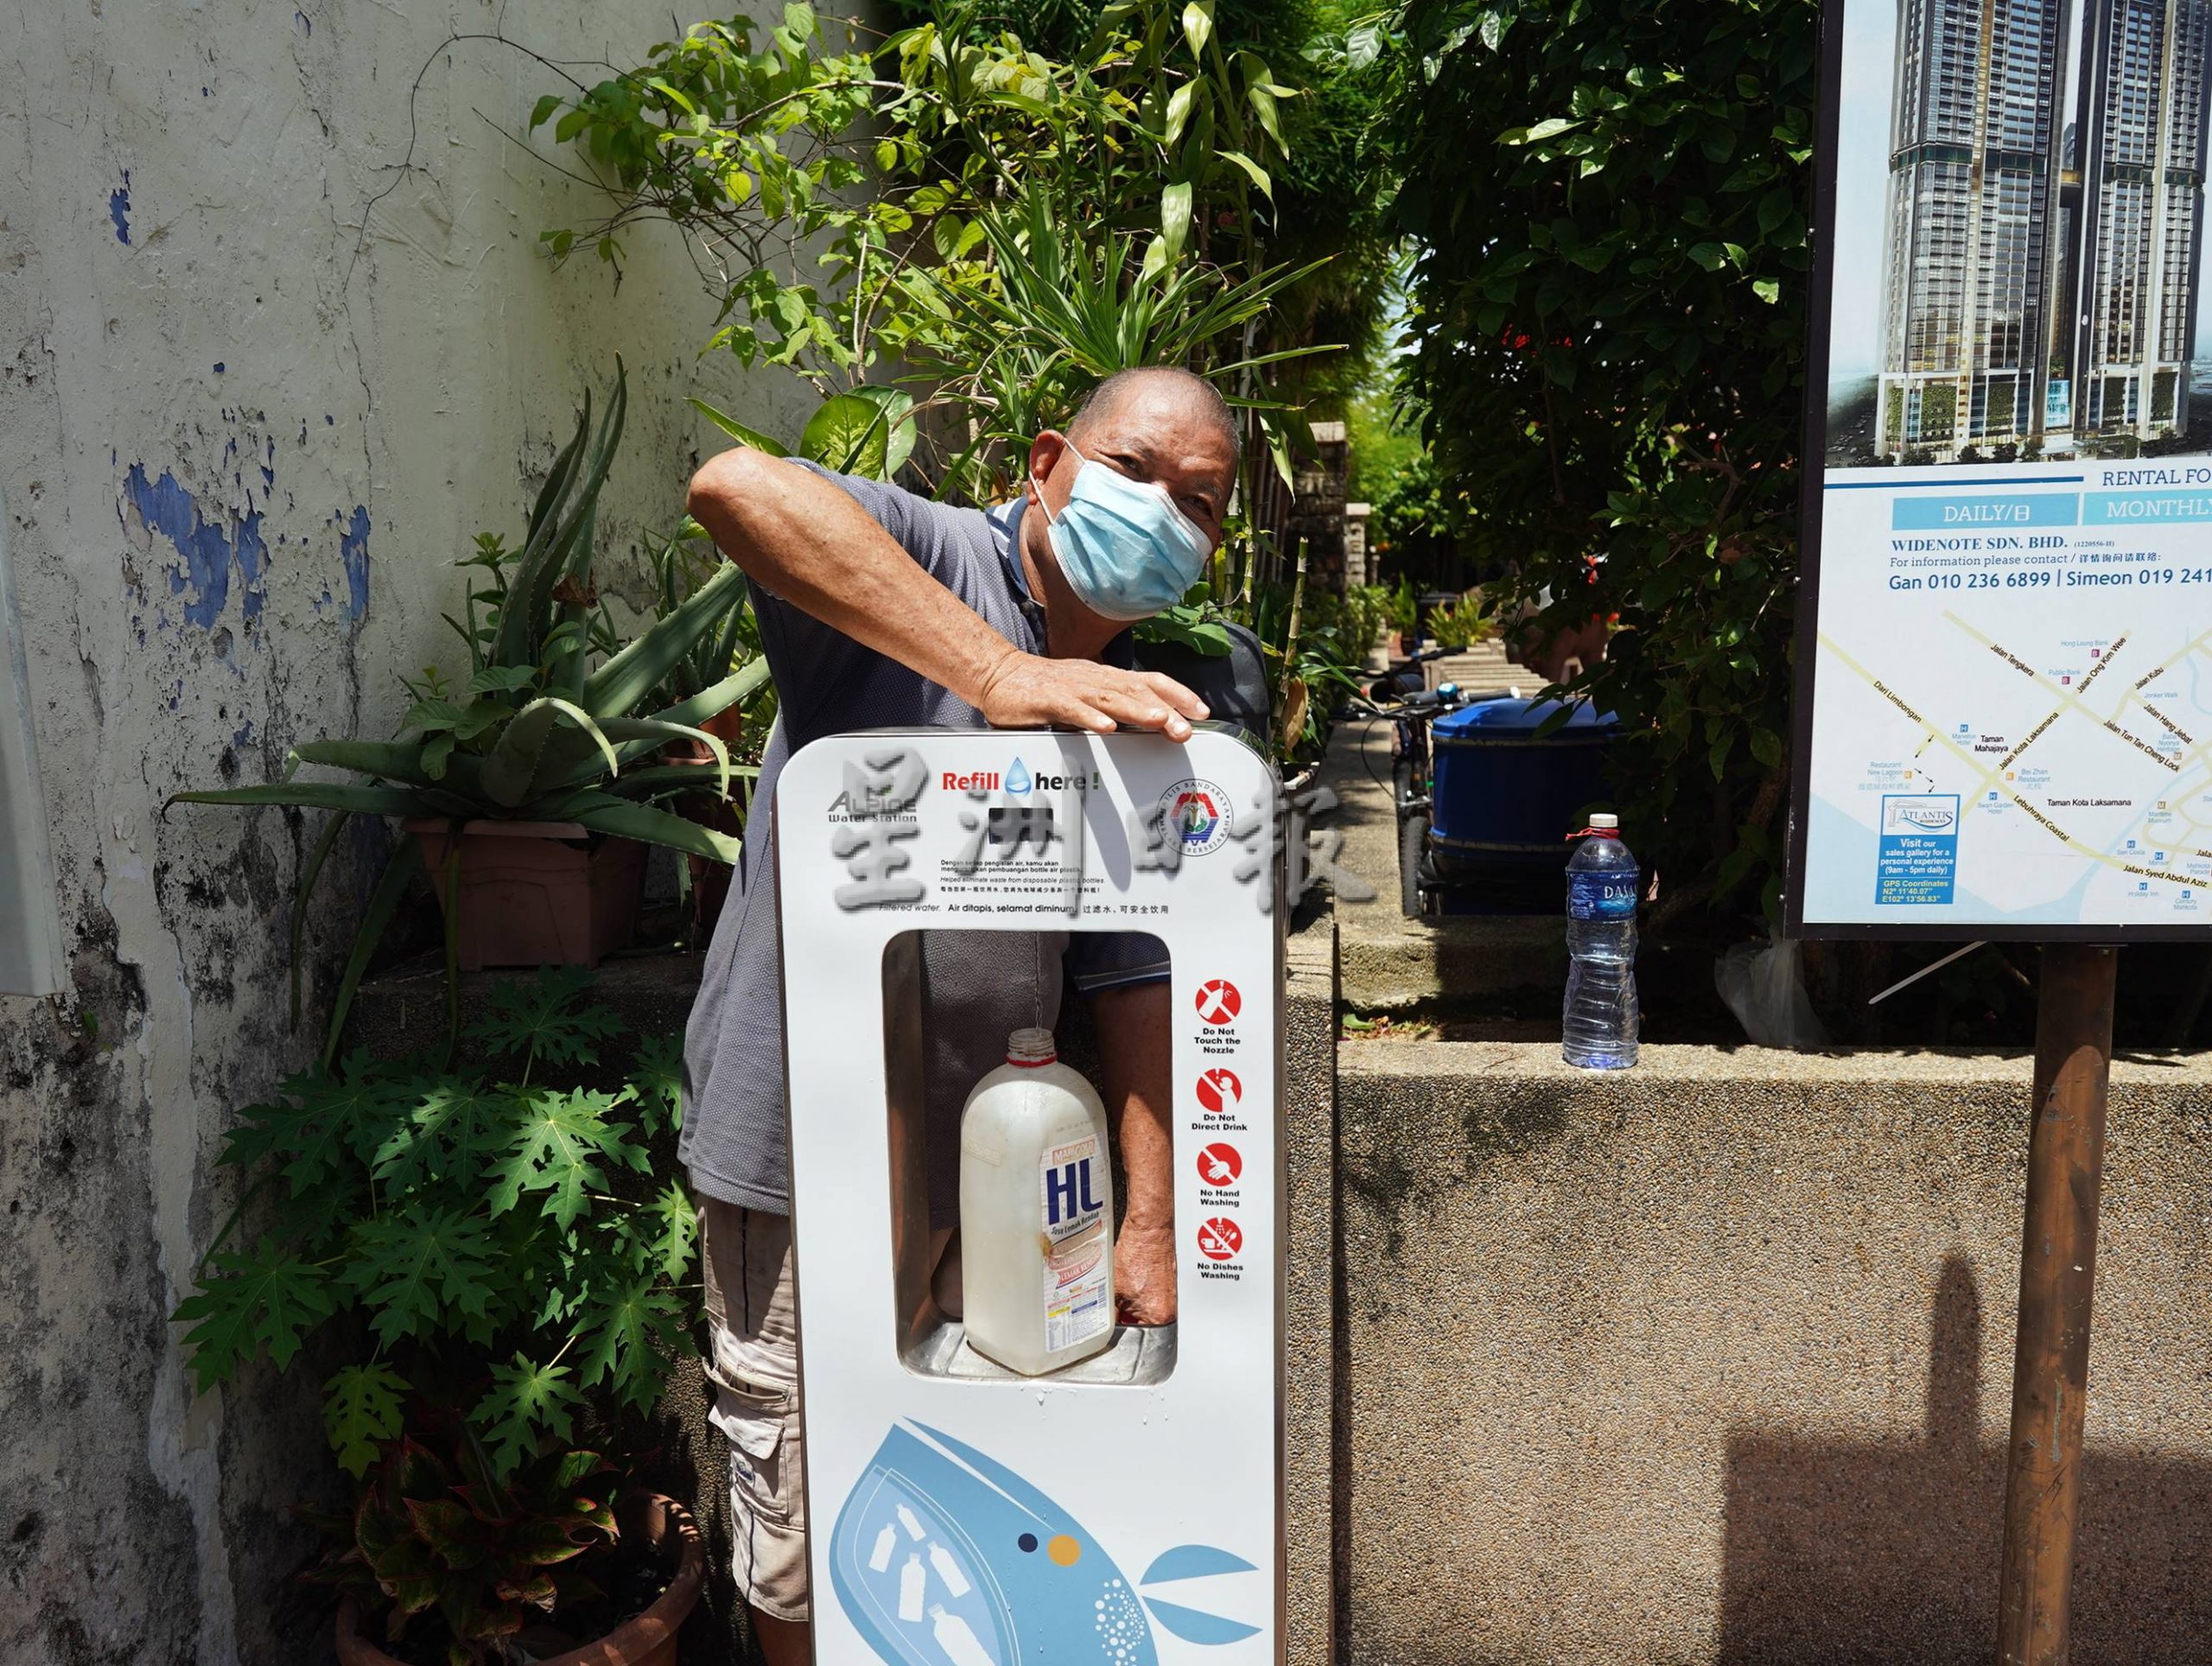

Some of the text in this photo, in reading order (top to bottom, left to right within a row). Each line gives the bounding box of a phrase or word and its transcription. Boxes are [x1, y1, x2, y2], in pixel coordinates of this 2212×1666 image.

[2102, 470, 2181, 486] RENTAL
[1892, 538, 1982, 551] WIDENOTE
[1986, 537, 2023, 550] SDN.
[2029, 536, 2068, 549] BHD.
[1890, 557, 1909, 567] For
[1911, 556, 1981, 566] information
[1984, 555, 2021, 568] please
[2024, 554, 2068, 564] contact
[1890, 575, 1923, 589] Gan
[1928, 574, 1961, 589] 010
[1967, 573, 2000, 588] 236
[2006, 571, 2050, 588] 6899
[2066, 570, 2133, 586] Simeon
[2139, 569, 2173, 584] 019
[2180, 568, 2212, 583] 241
[1990, 644, 2035, 677] Jalan Tengkera
[2077, 637, 2126, 693] Jalan Ong Kim Wee
[2134, 666, 2164, 690] Jalan Kubu
[1873, 681, 1922, 722] Dari Limbongan
[2144, 703, 2192, 744] Jalan Hang Jebat
[1999, 712, 2059, 771] Jalan Kota Laksamana
[2103, 720, 2180, 773] Jalan Tun Tan Cheng Lock
[1974, 745, 2009, 754] Mahajaya
[943, 772, 999, 790] Refill
[1035, 773, 1085, 791] here
[829, 814, 917, 823] Water Station
[2013, 795, 2069, 842] Lebuhraya Coastal
[1900, 838, 1922, 848] Visit
[1906, 849, 1931, 858] gallery
[1914, 858, 1954, 867] experience
[1885, 866, 1904, 874] (9am
[1927, 866, 1948, 874] daily)
[2123, 865, 2208, 888] Jalan Syed Abdul Aziz
[948, 904, 961, 912] Air
[962, 904, 995, 913] ditapis,
[996, 904, 1033, 912] selamat
[1203, 1027, 1236, 1036] Do Not
[1194, 1037, 1241, 1046] Touch the
[1203, 1046, 1235, 1054] Nozzle
[1204, 1114, 1236, 1122] Do Not
[1192, 1122, 1248, 1132] Direct Drink
[1046, 1158, 1103, 1226] HL
[1200, 1189, 1240, 1198] No Hand
[1200, 1199, 1240, 1208] Washing
[1198, 1262, 1243, 1271] No Dishes
[1201, 1271, 1240, 1281] Washing
